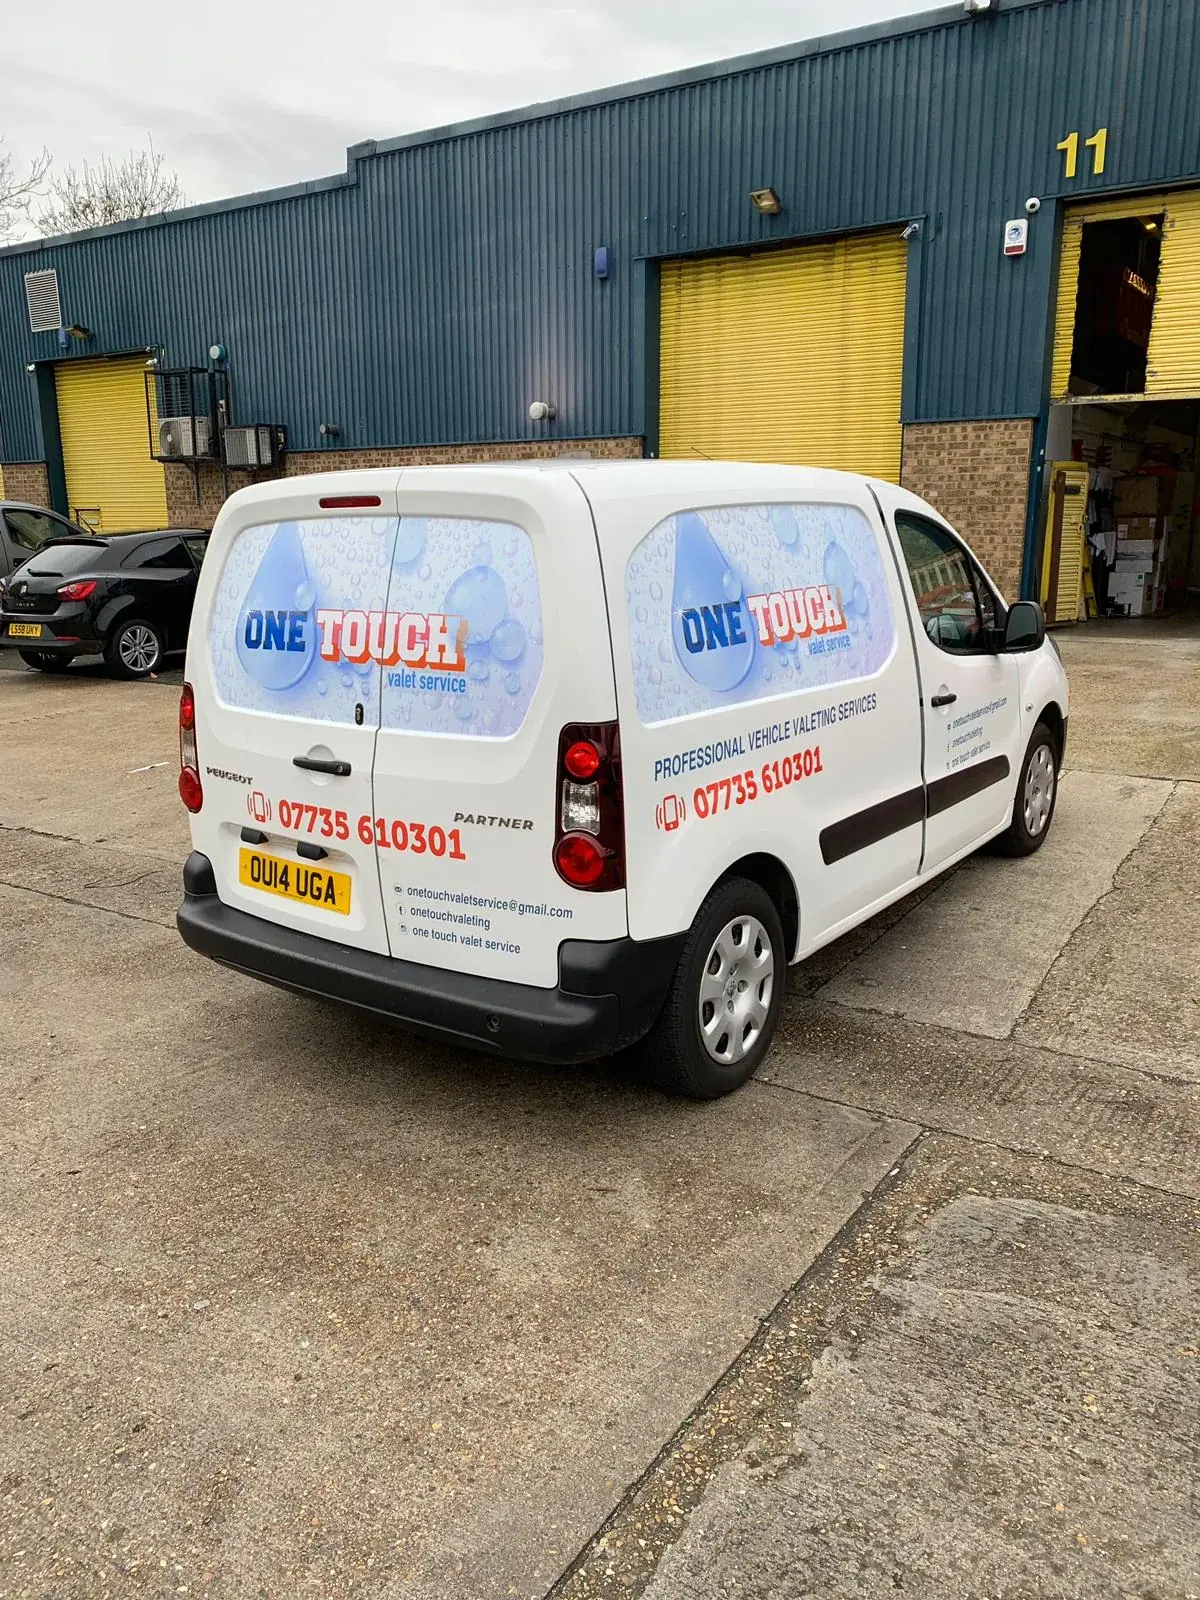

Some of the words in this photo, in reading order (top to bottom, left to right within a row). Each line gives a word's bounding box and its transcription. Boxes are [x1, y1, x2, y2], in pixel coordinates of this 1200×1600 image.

[1056, 128, 1107, 177] 11
[681, 601, 747, 654] ONE
[746, 584, 848, 647] TOUCH
[244, 609, 308, 652] ONE
[316, 608, 468, 672] TOUCH
[808, 638, 826, 655] valet
[827, 634, 851, 651] service
[387, 668, 416, 689] valet
[419, 673, 467, 693] service
[654, 735, 745, 781] PROFESSIONAL
[748, 720, 790, 750] VEHICLE
[793, 706, 836, 736] VALETING
[838, 693, 877, 721] SERVICES
[206, 766, 253, 785] PEUGEOT
[693, 769, 758, 819] 07735
[761, 745, 823, 794] 610301
[278, 799, 350, 841] 07735
[357, 815, 466, 860] 610301
[453, 812, 534, 831] PARTNER
[250, 855, 290, 892] OU14
[296, 867, 337, 905] UGA
[407, 887, 573, 919] onetouchvaletservice@gmail.com
[410, 906, 491, 930] onetouchvaleting
[412, 926, 429, 937] one
[431, 929, 457, 943] touch
[459, 936, 483, 948] valet
[485, 940, 521, 954] service
